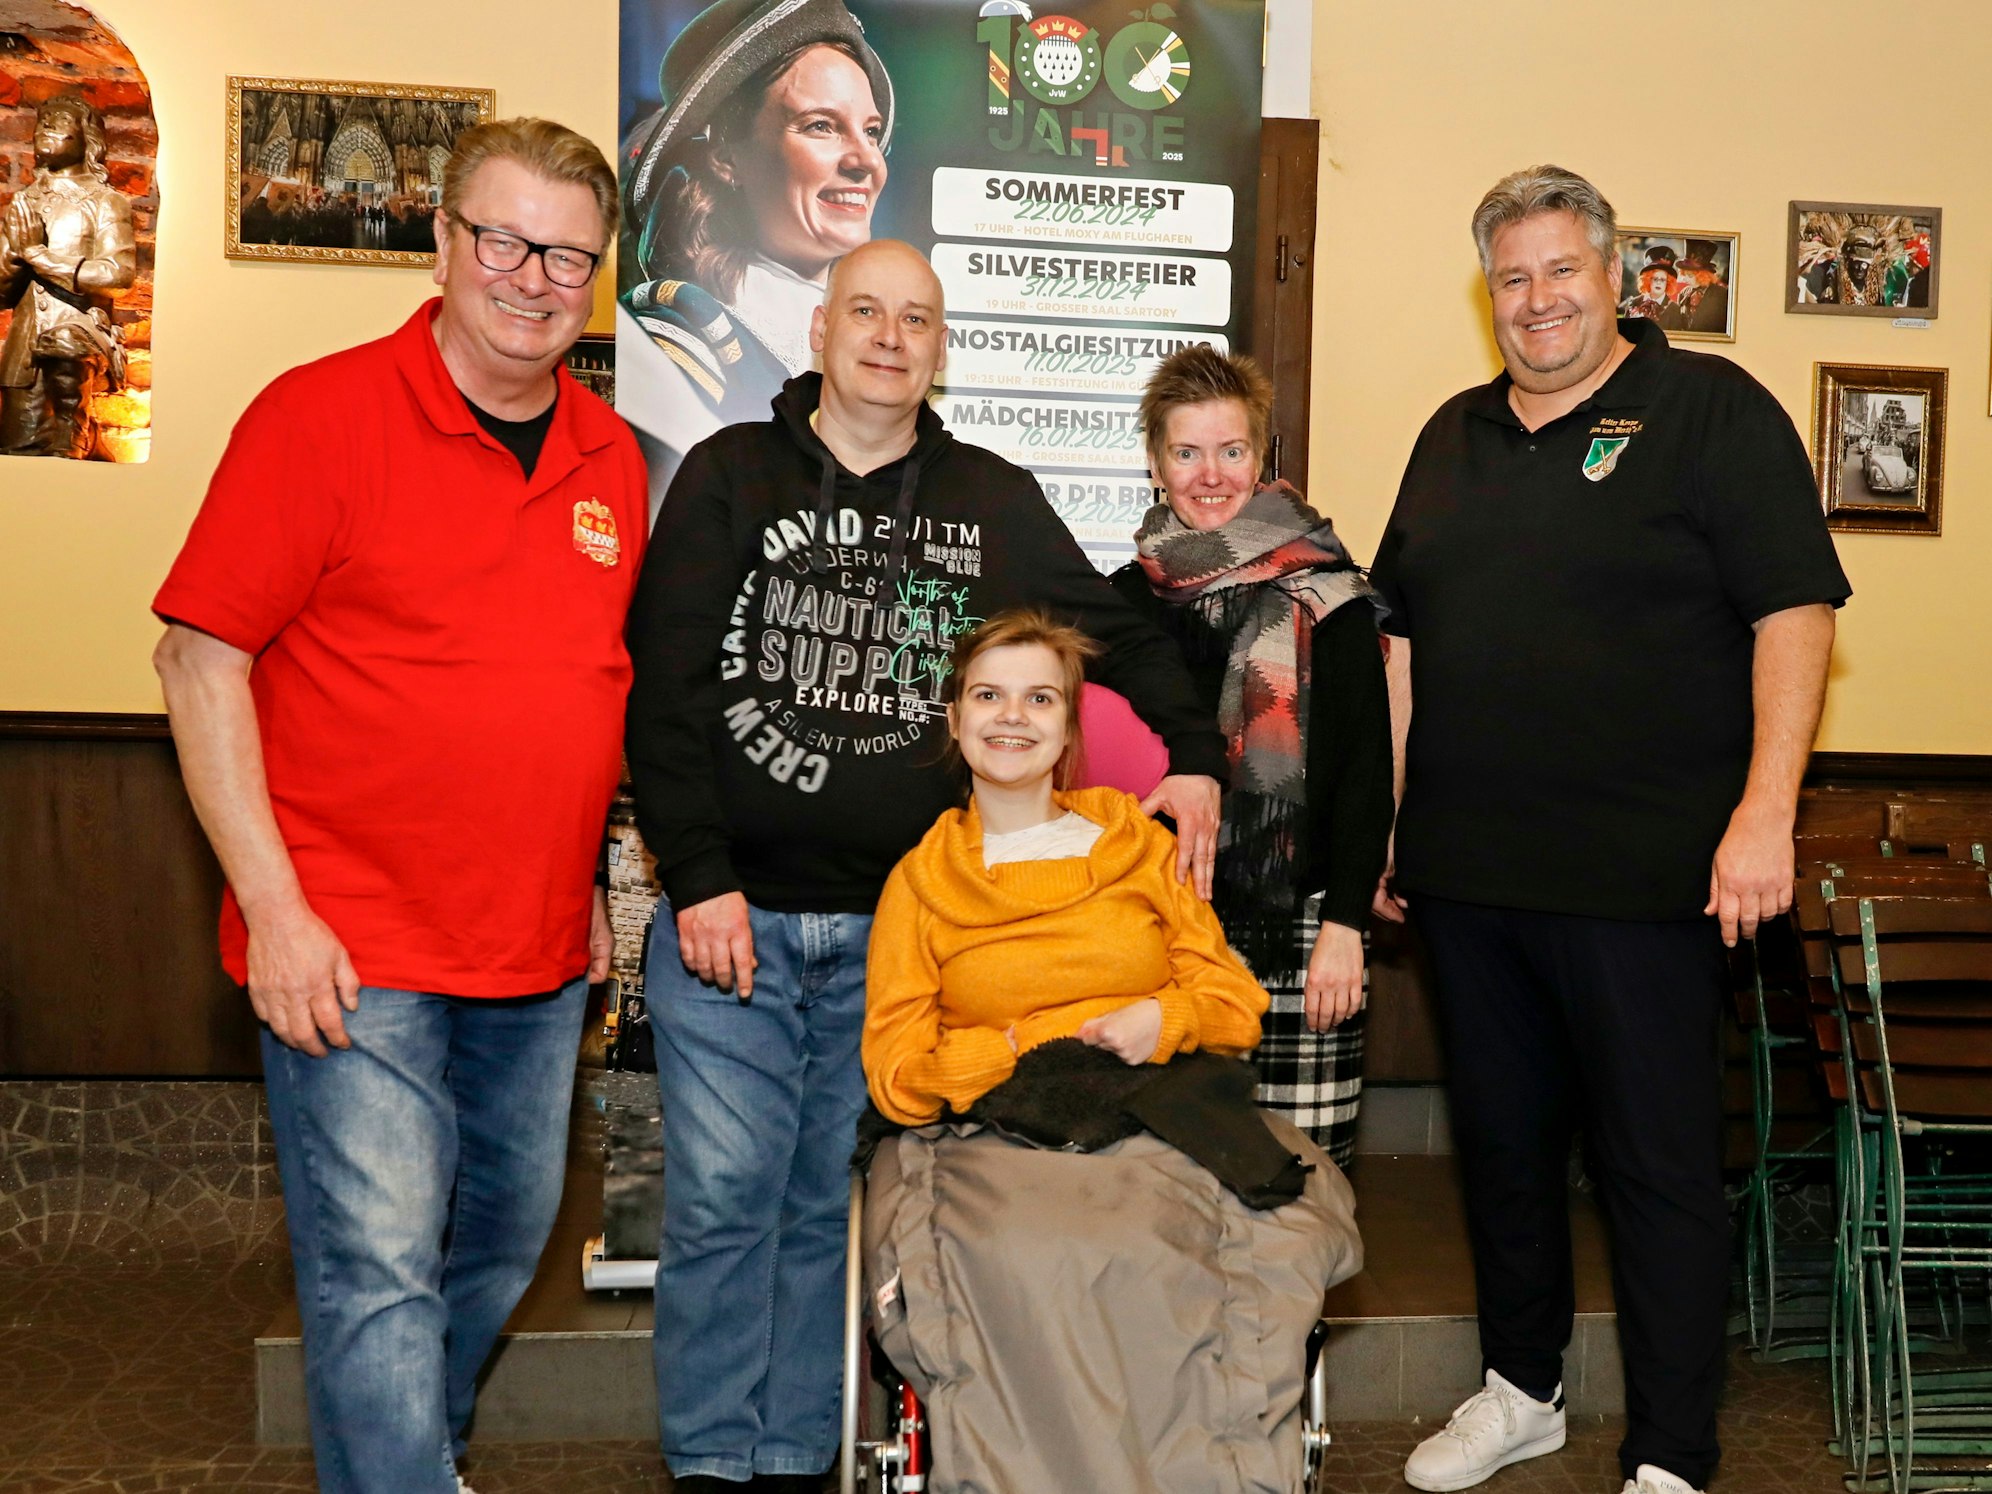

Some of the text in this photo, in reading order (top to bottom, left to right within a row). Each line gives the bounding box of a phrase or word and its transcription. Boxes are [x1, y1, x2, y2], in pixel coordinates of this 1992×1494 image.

[1048, 89, 1067, 98] JvW
[988, 106, 1009, 115] 1925
[988, 99, 1185, 165] JAHRE
[1162, 152, 1184, 161] 2025
[985, 177, 1185, 210] SOMMERFEST
[1013, 199, 1158, 227] 22.06.2024
[974, 222, 987, 232] 17
[989, 223, 1014, 234] UHR
[1024, 225, 1062, 237] HOTEL
[1065, 227, 1100, 239] MOXY
[1103, 229, 1122, 240] AM
[1125, 231, 1193, 244] FLUGHAFEN
[967, 253, 1197, 286] SILVESTERFEIER
[1020, 275, 1150, 301] 31.12.2024
[985, 299, 999, 309] 19
[1001, 301, 1026, 312] UHR
[1036, 302, 1089, 314] GROSSER
[1092, 304, 1121, 316] SAAL
[1123, 306, 1178, 318] SARTORY
[1024, 351, 1141, 376] 11.01.2025
[998, 375, 1022, 385] UHR
[1032, 376, 1108, 390] FESTSITZUNG
[951, 399, 1146, 431] MÄDCHENSITZ
[1018, 425, 1139, 449] 16.01.2025
[1032, 451, 1085, 463] GROSSER
[1087, 454, 1117, 464] SAAL
[941, 523, 980, 547] TM
[924, 542, 981, 563] MISSION
[946, 560, 981, 578] BLUE
[762, 576, 955, 652] NAUTICAL
[758, 629, 949, 702] SUPPLY
[795, 686, 895, 716] EXPLORE
[764, 698, 922, 756] A SILENT WORLD
[723, 697, 830, 793] CREW
